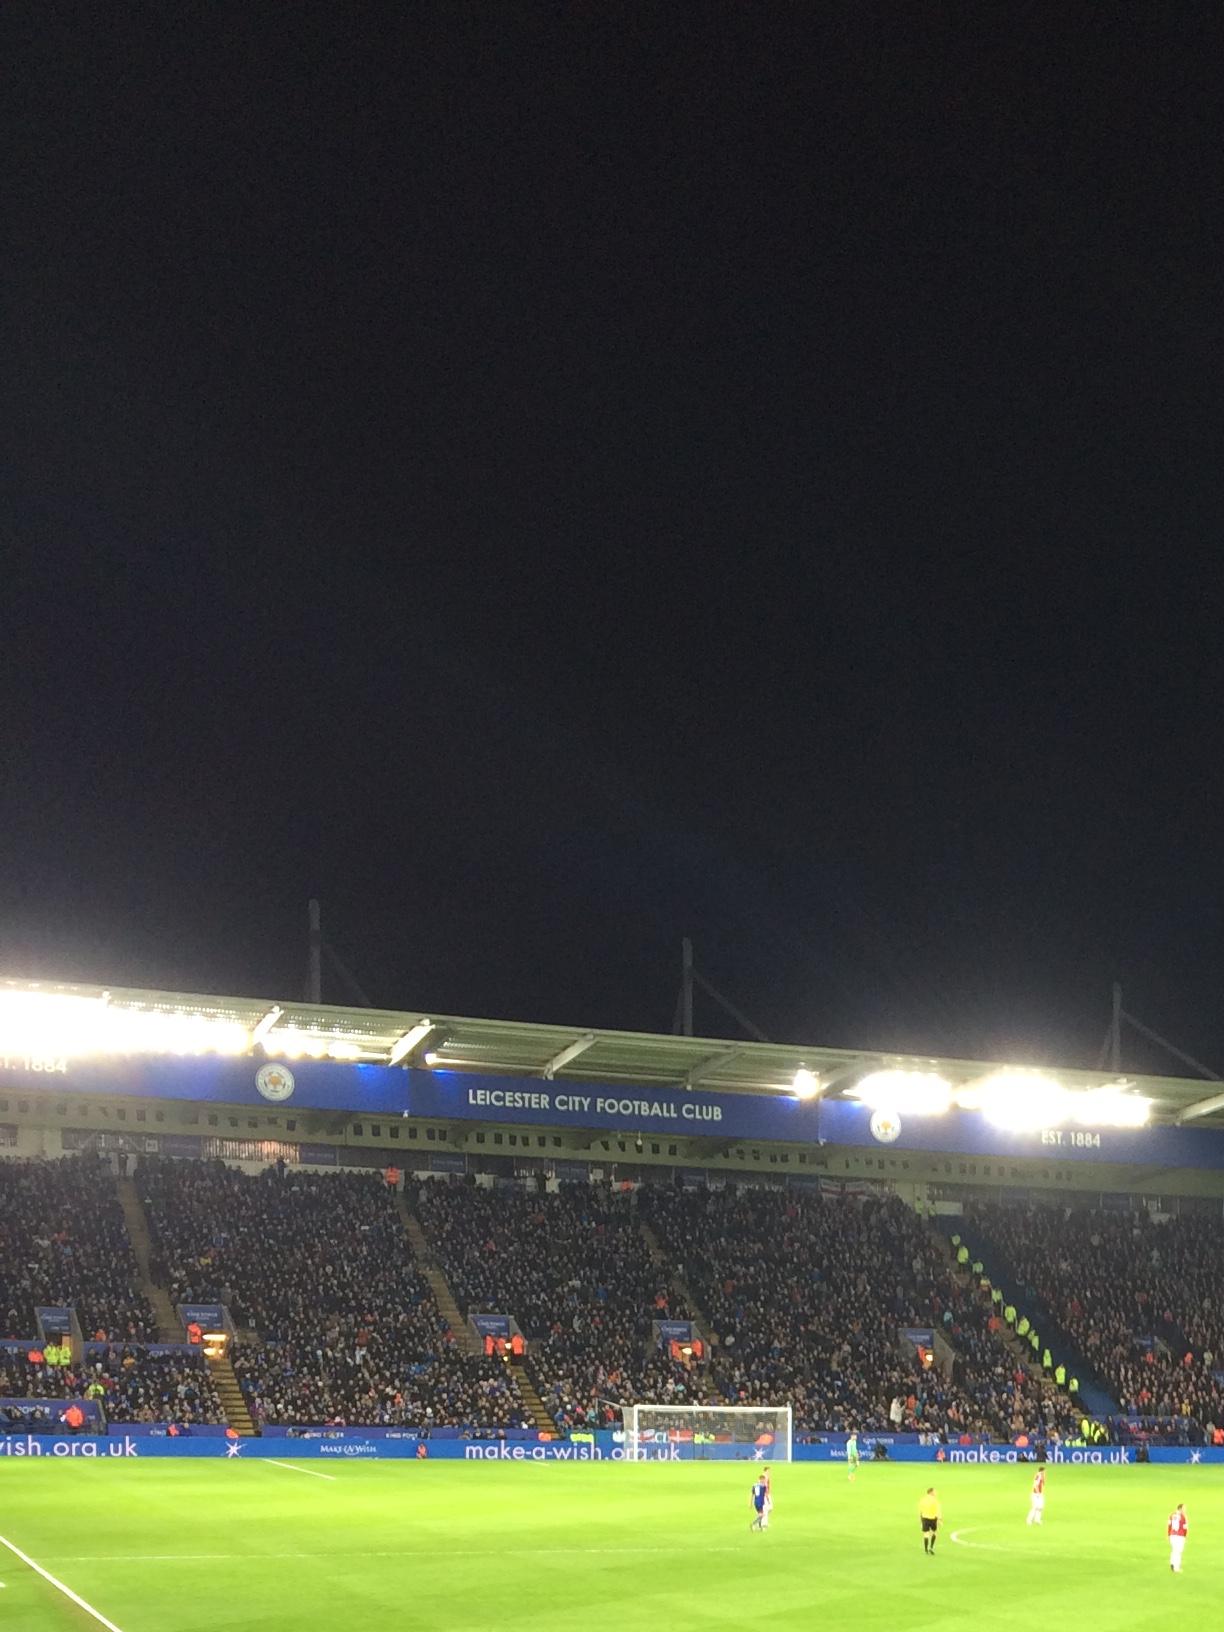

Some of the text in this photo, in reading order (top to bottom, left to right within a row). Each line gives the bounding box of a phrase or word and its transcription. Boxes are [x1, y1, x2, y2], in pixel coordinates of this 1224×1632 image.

[468, 1088, 723, 1121] LEICESTER CITY FOOTBALL CLUB
[1041, 1128, 1101, 1149] EST. 1884
[465, 1440, 681, 1461] make-a-wish.org.uk
